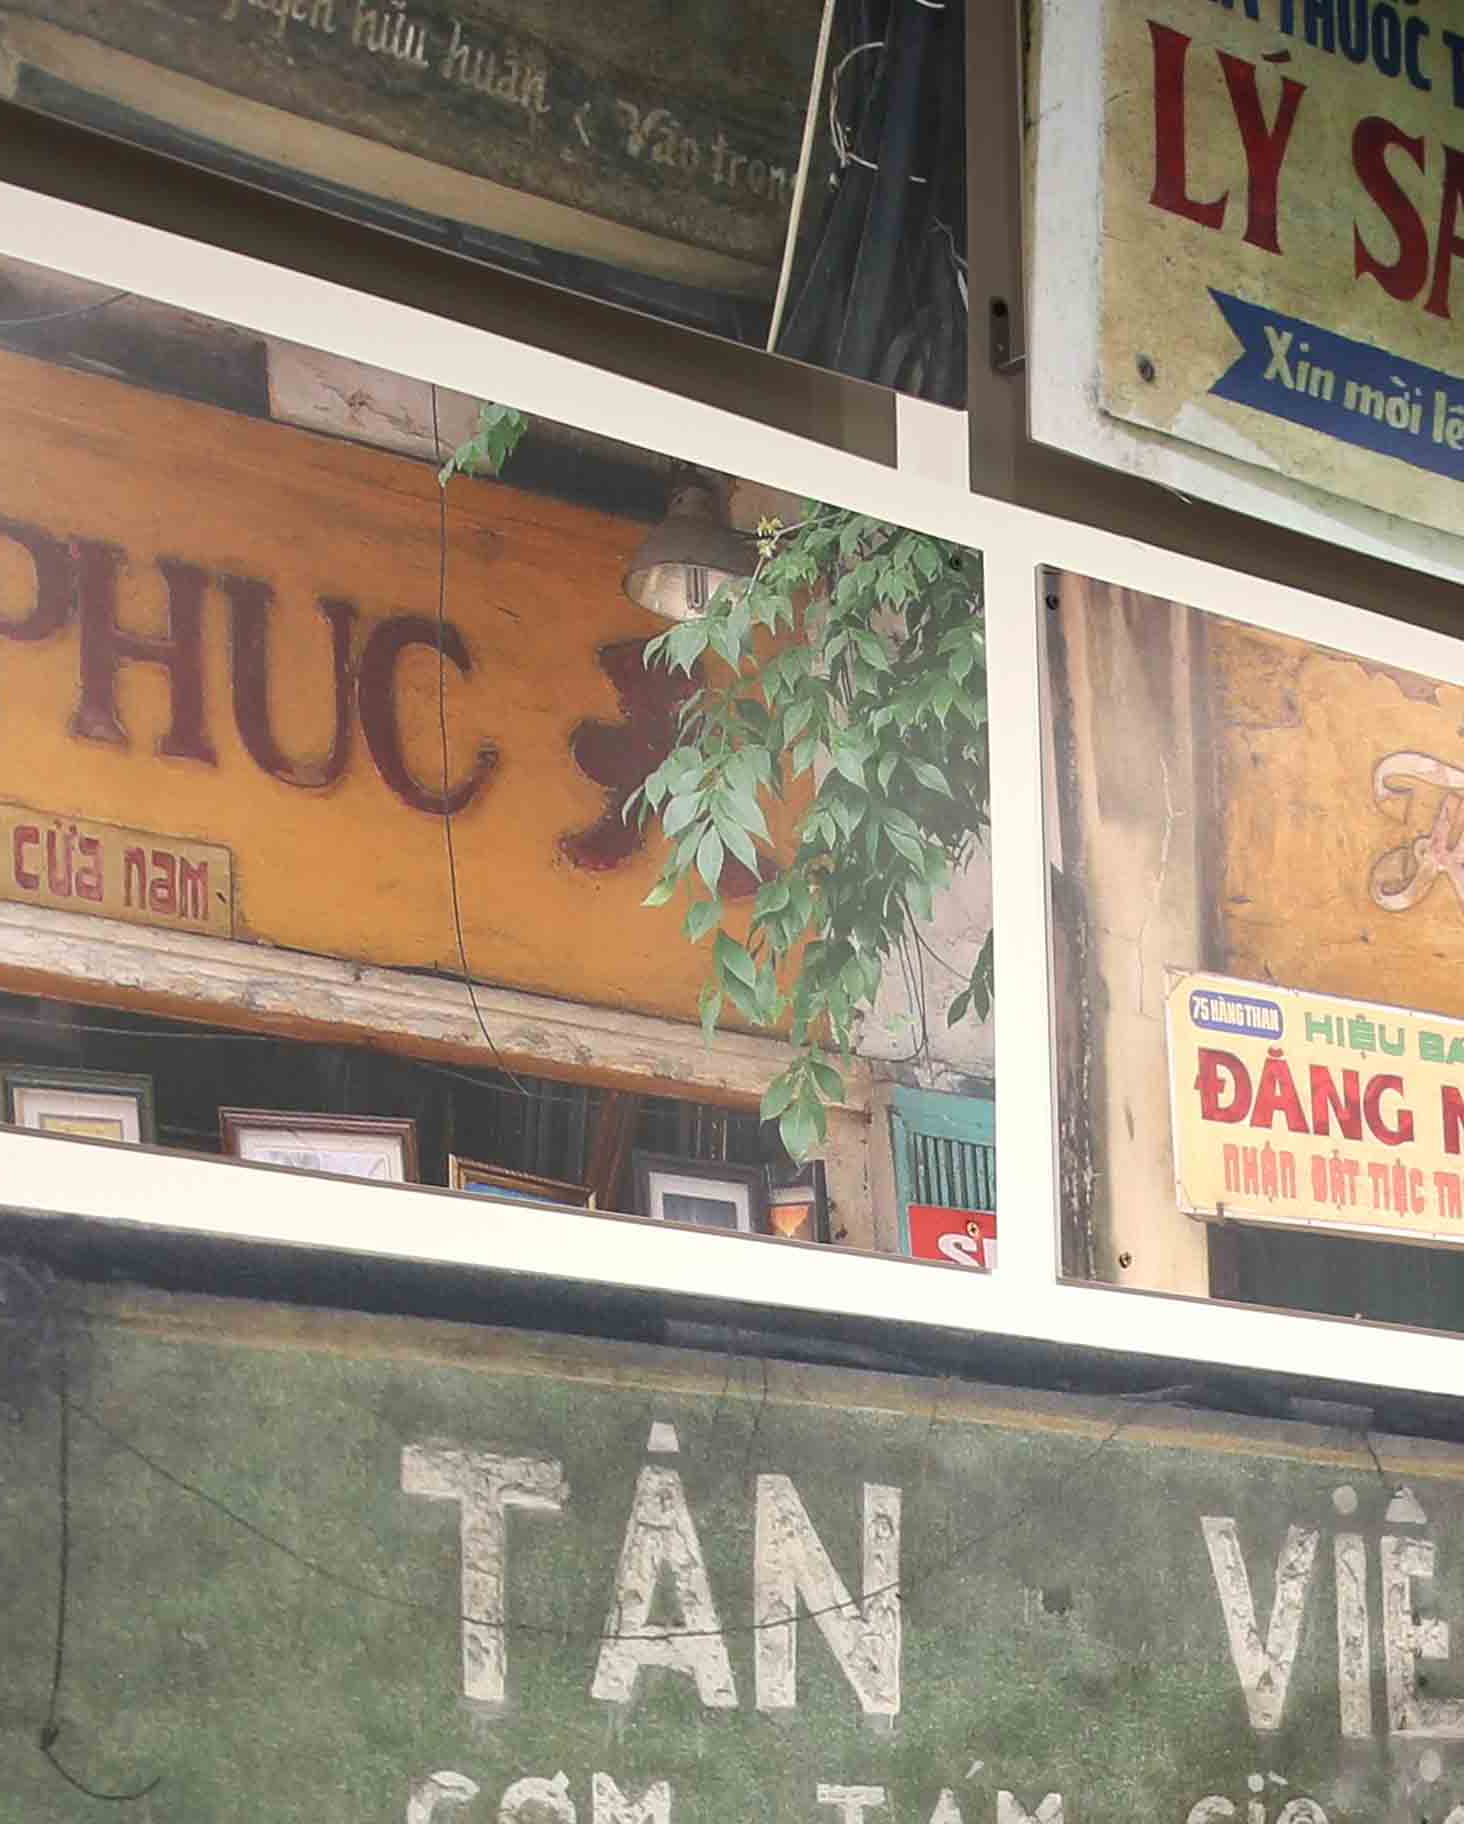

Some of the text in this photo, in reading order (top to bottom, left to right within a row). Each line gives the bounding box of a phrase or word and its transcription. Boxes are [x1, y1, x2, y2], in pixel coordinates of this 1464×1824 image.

[1145, 18, 1307, 256] LÝ
[1262, 324, 1336, 402] Xin
[1192, 995, 1210, 1019] 75
[1193, 1046, 1416, 1147] ĐĂNG
[399, 1420, 903, 1718] TÂN
